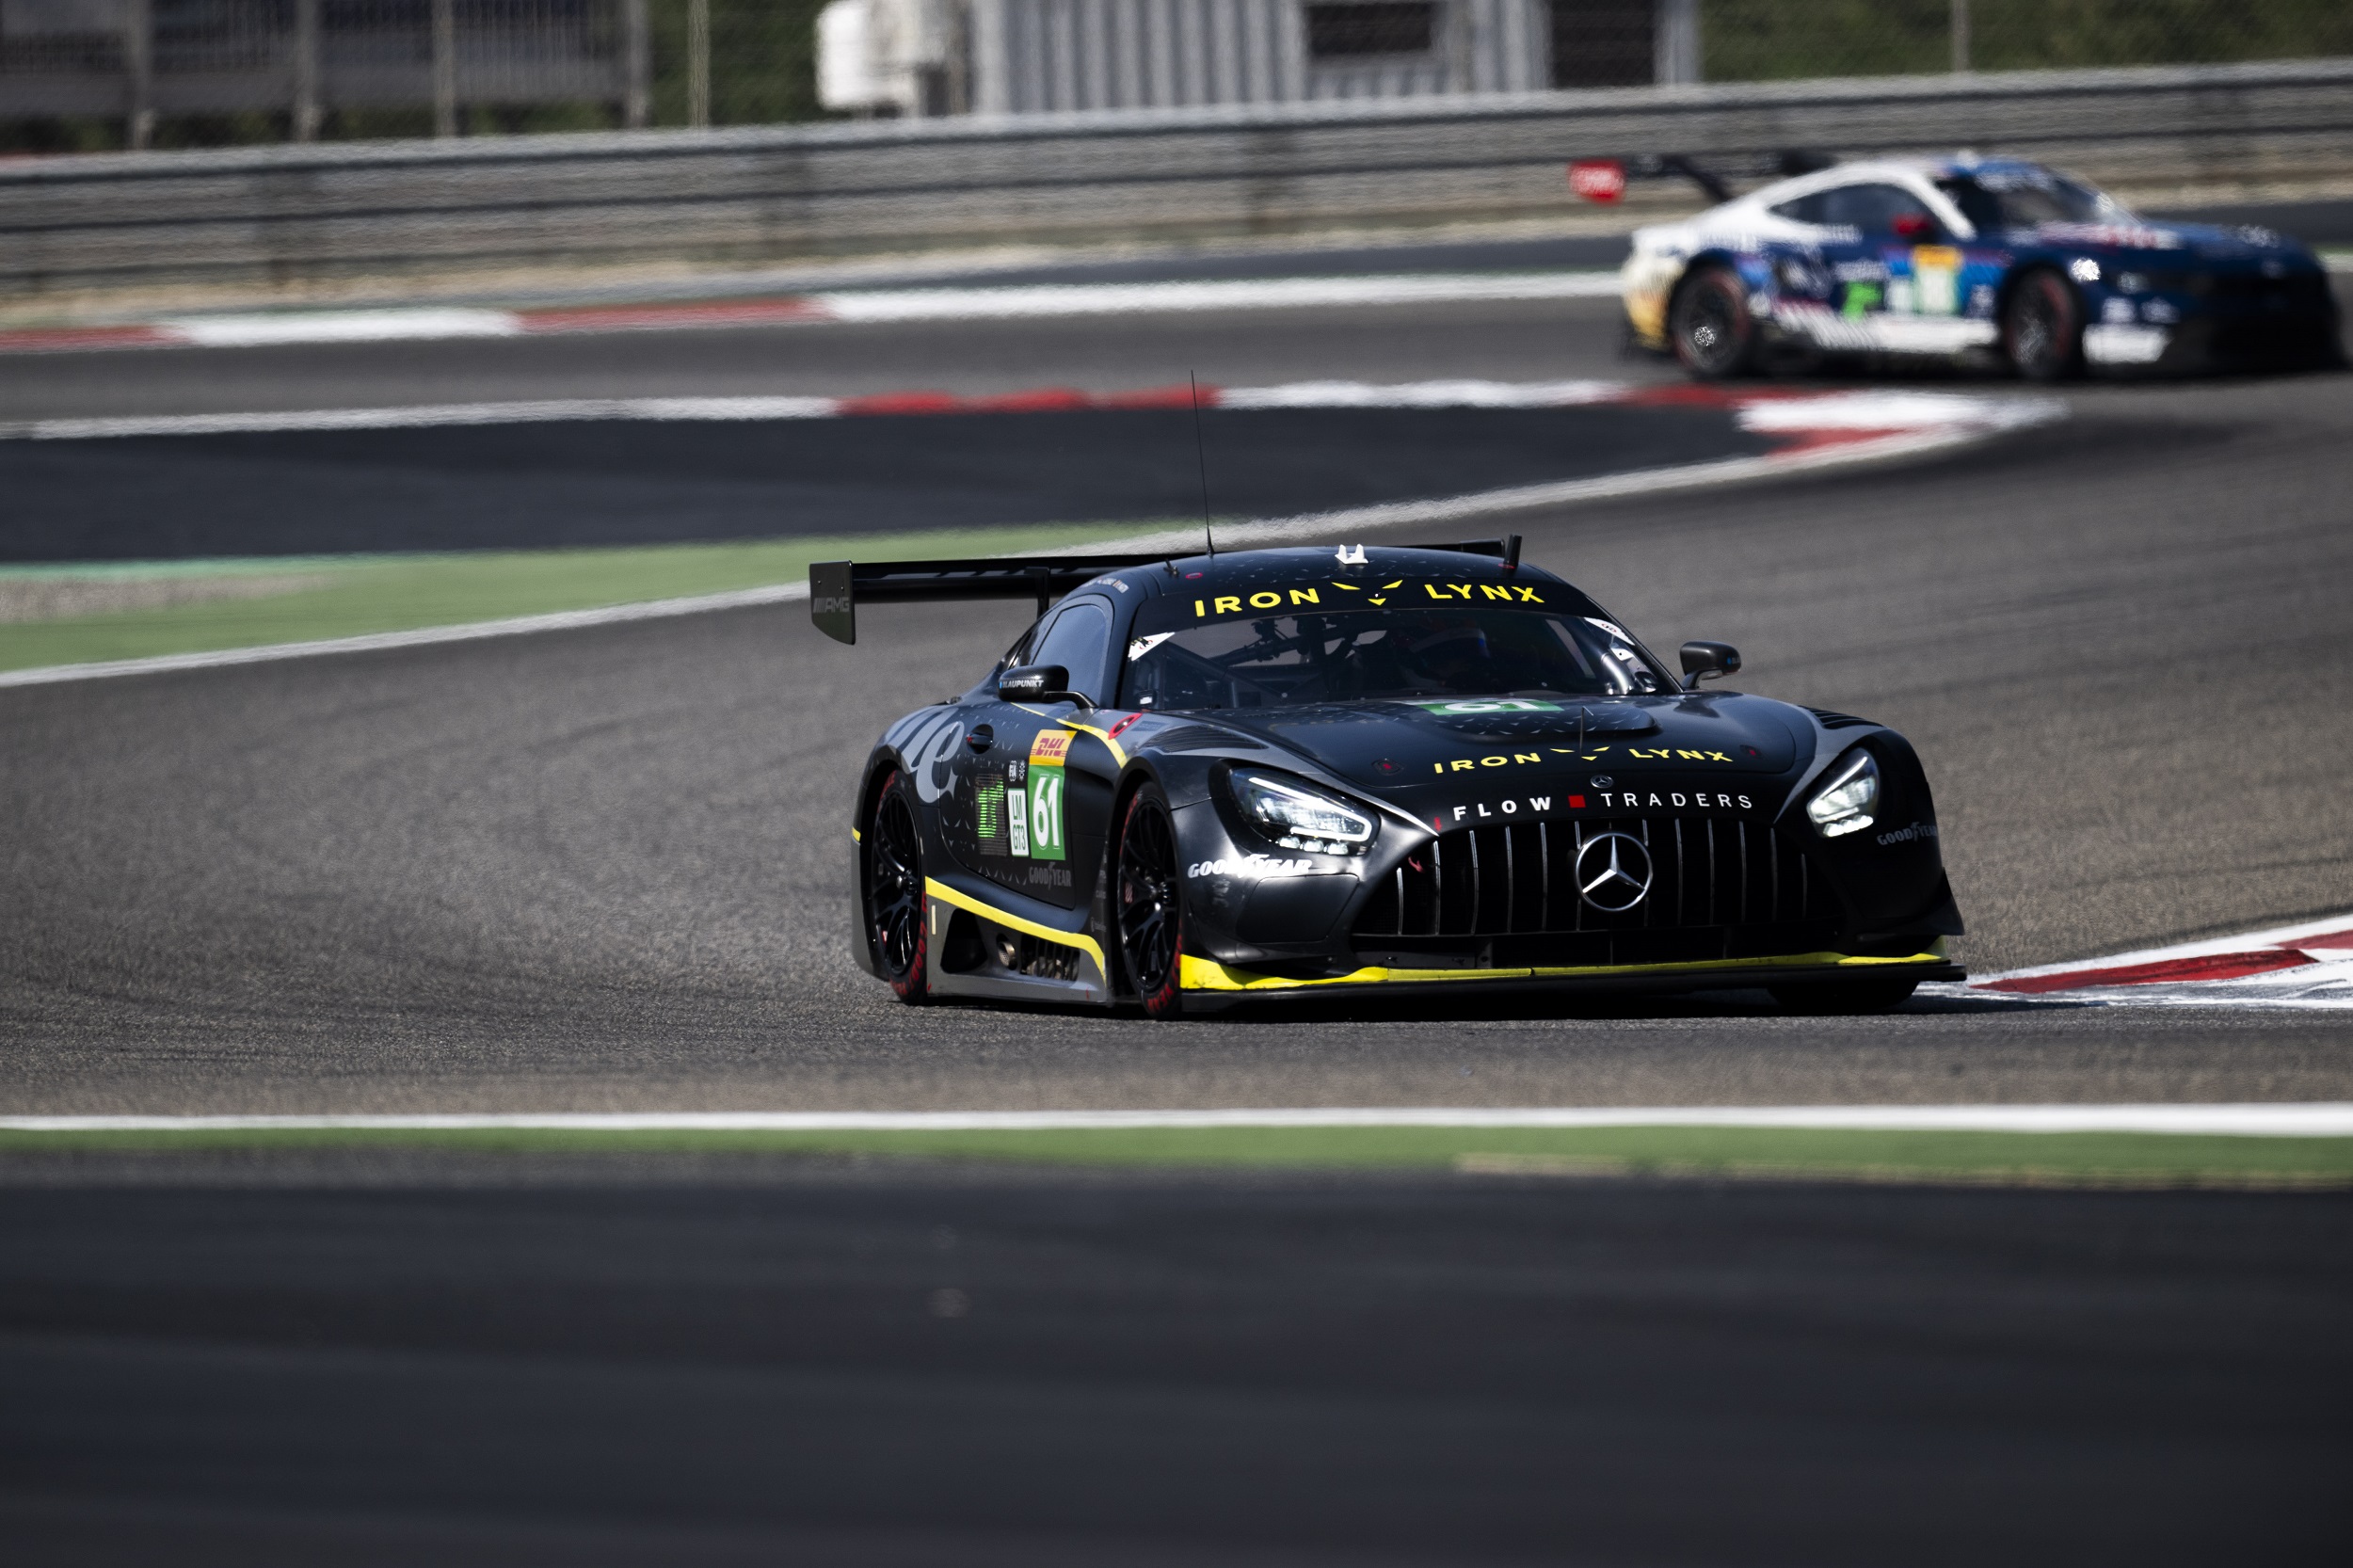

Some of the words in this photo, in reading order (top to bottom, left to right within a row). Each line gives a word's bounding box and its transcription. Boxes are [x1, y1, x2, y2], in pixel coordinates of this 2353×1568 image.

[824, 596, 850, 613] AMG
[1194, 587, 1321, 617] IRON
[1424, 584, 1545, 603] LYNX
[1002, 679, 1044, 688] BLAUPUNKT
[1444, 700, 1542, 712] 61
[1036, 737, 1065, 757] DHL
[1433, 752, 1542, 774] IRON
[1628, 748, 1733, 762] LYNX
[1011, 794, 1023, 821] LM
[1032, 776, 1060, 848] 61
[1452, 796, 1551, 821] FLOW
[1600, 792, 1753, 809] TRADERS
[1013, 824, 1026, 851] GT3
[1877, 822, 1938, 845] GOODYEA
[1028, 862, 1072, 889] GOODYEAR
[1188, 854, 1313, 878] GOOYEAR
